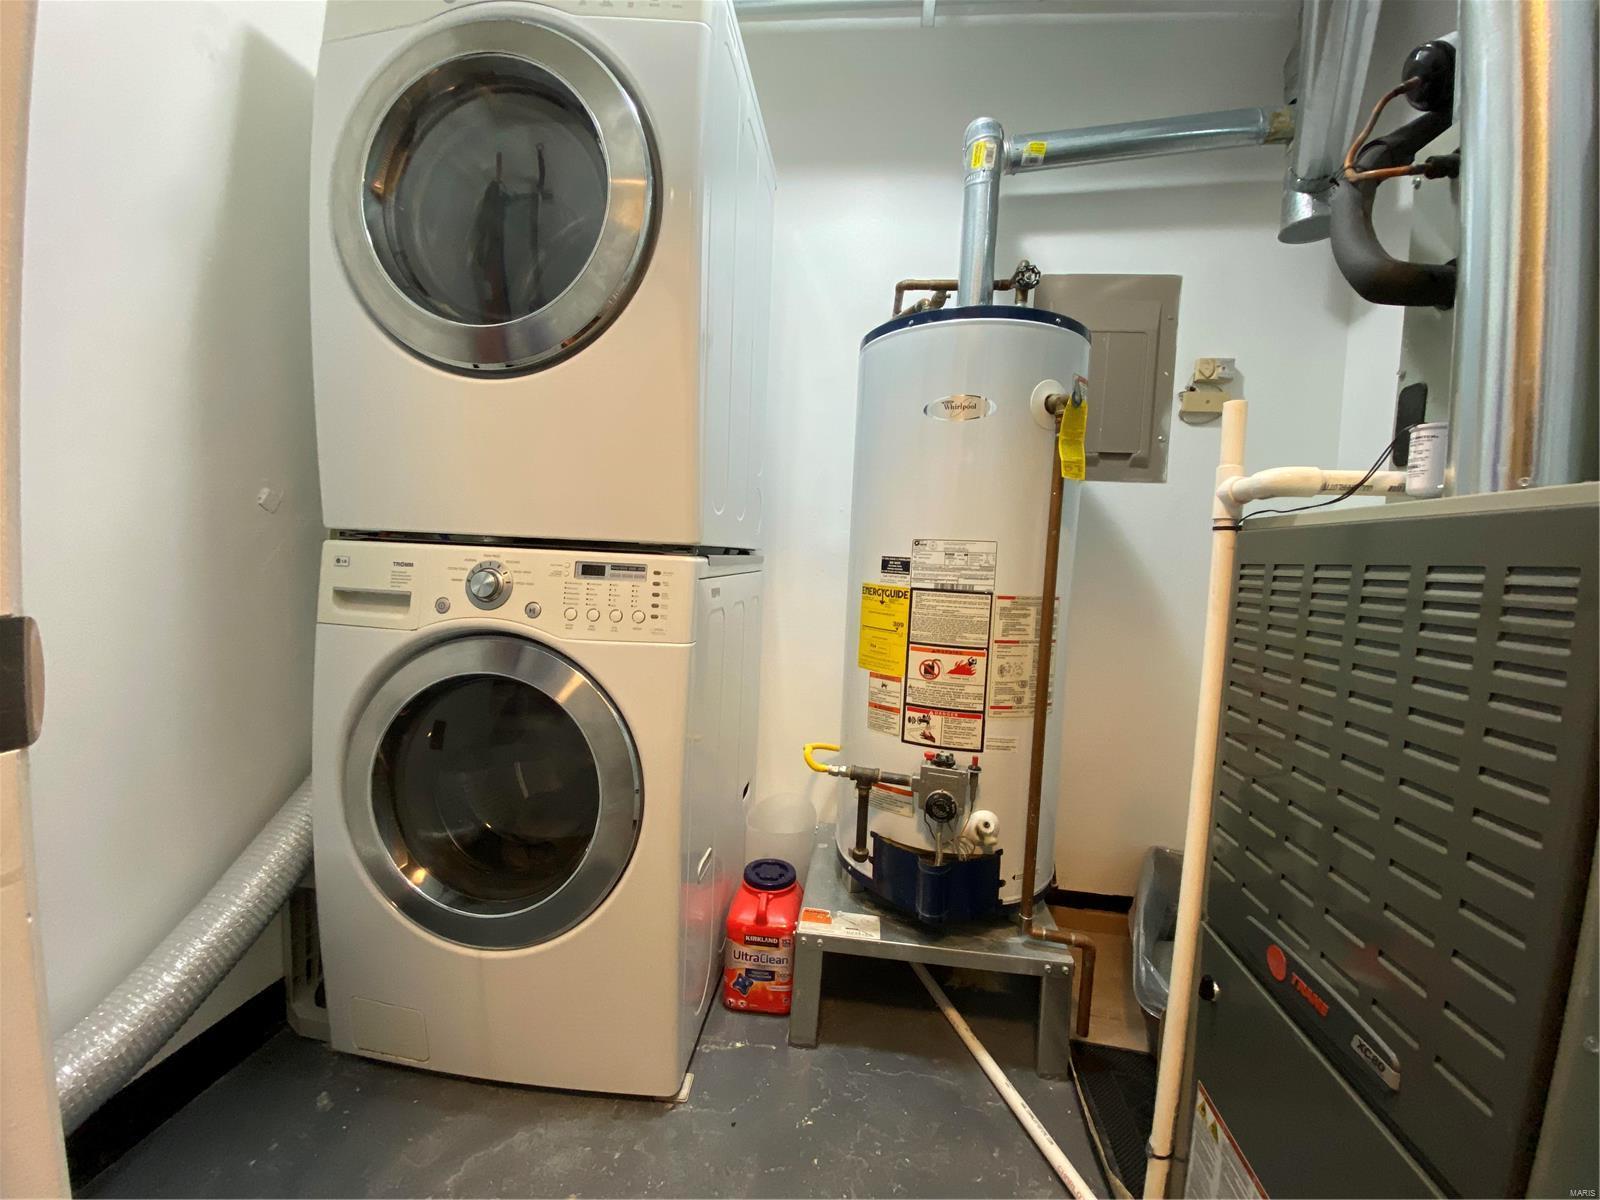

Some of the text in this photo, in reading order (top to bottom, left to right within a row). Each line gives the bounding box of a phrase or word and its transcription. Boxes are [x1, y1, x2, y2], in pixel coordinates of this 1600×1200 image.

[943, 402, 977, 410] Whirlpool
[745, 935, 779, 945] KIRKLAND
[733, 949, 789, 965] UltraClean
